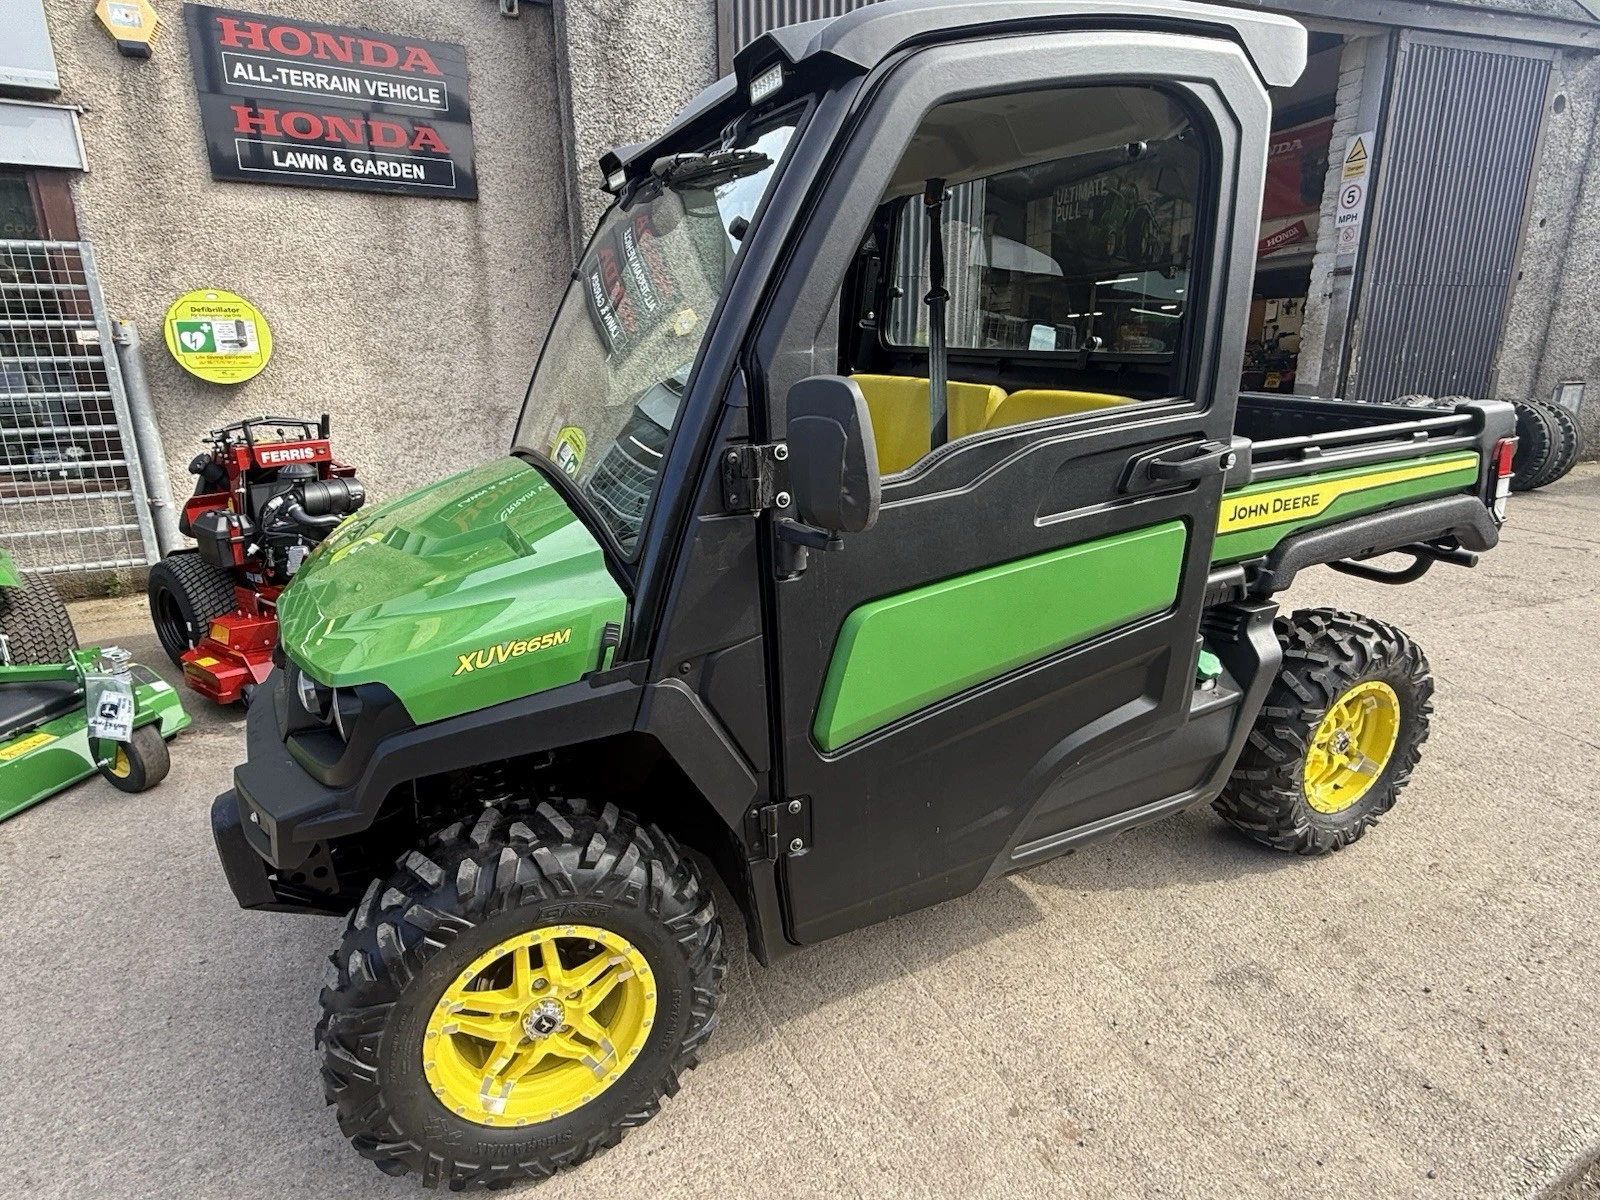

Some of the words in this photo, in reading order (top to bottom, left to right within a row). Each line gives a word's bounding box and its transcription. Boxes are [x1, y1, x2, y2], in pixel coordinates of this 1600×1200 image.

[216, 17, 443, 76] HONDA
[233, 62, 361, 94] ALL-TERRAIN
[364, 79, 441, 104] VEHICLE
[231, 105, 450, 153] HONDA
[272, 150, 329, 172] LAWN
[332, 156, 347, 172] &
[350, 157, 425, 180] GARDEN
[1057, 177, 1109, 206] ULTIMATE
[1346, 190, 1356, 204] 5
[1056, 202, 1081, 222] PULL
[1338, 213, 1358, 224] MPH
[1266, 227, 1299, 247] HONDA
[261, 447, 315, 464] FERRIS
[1228, 502, 1269, 521] JOHN
[1272, 493, 1320, 513] DEERE
[452, 627, 572, 677] XUV865M
